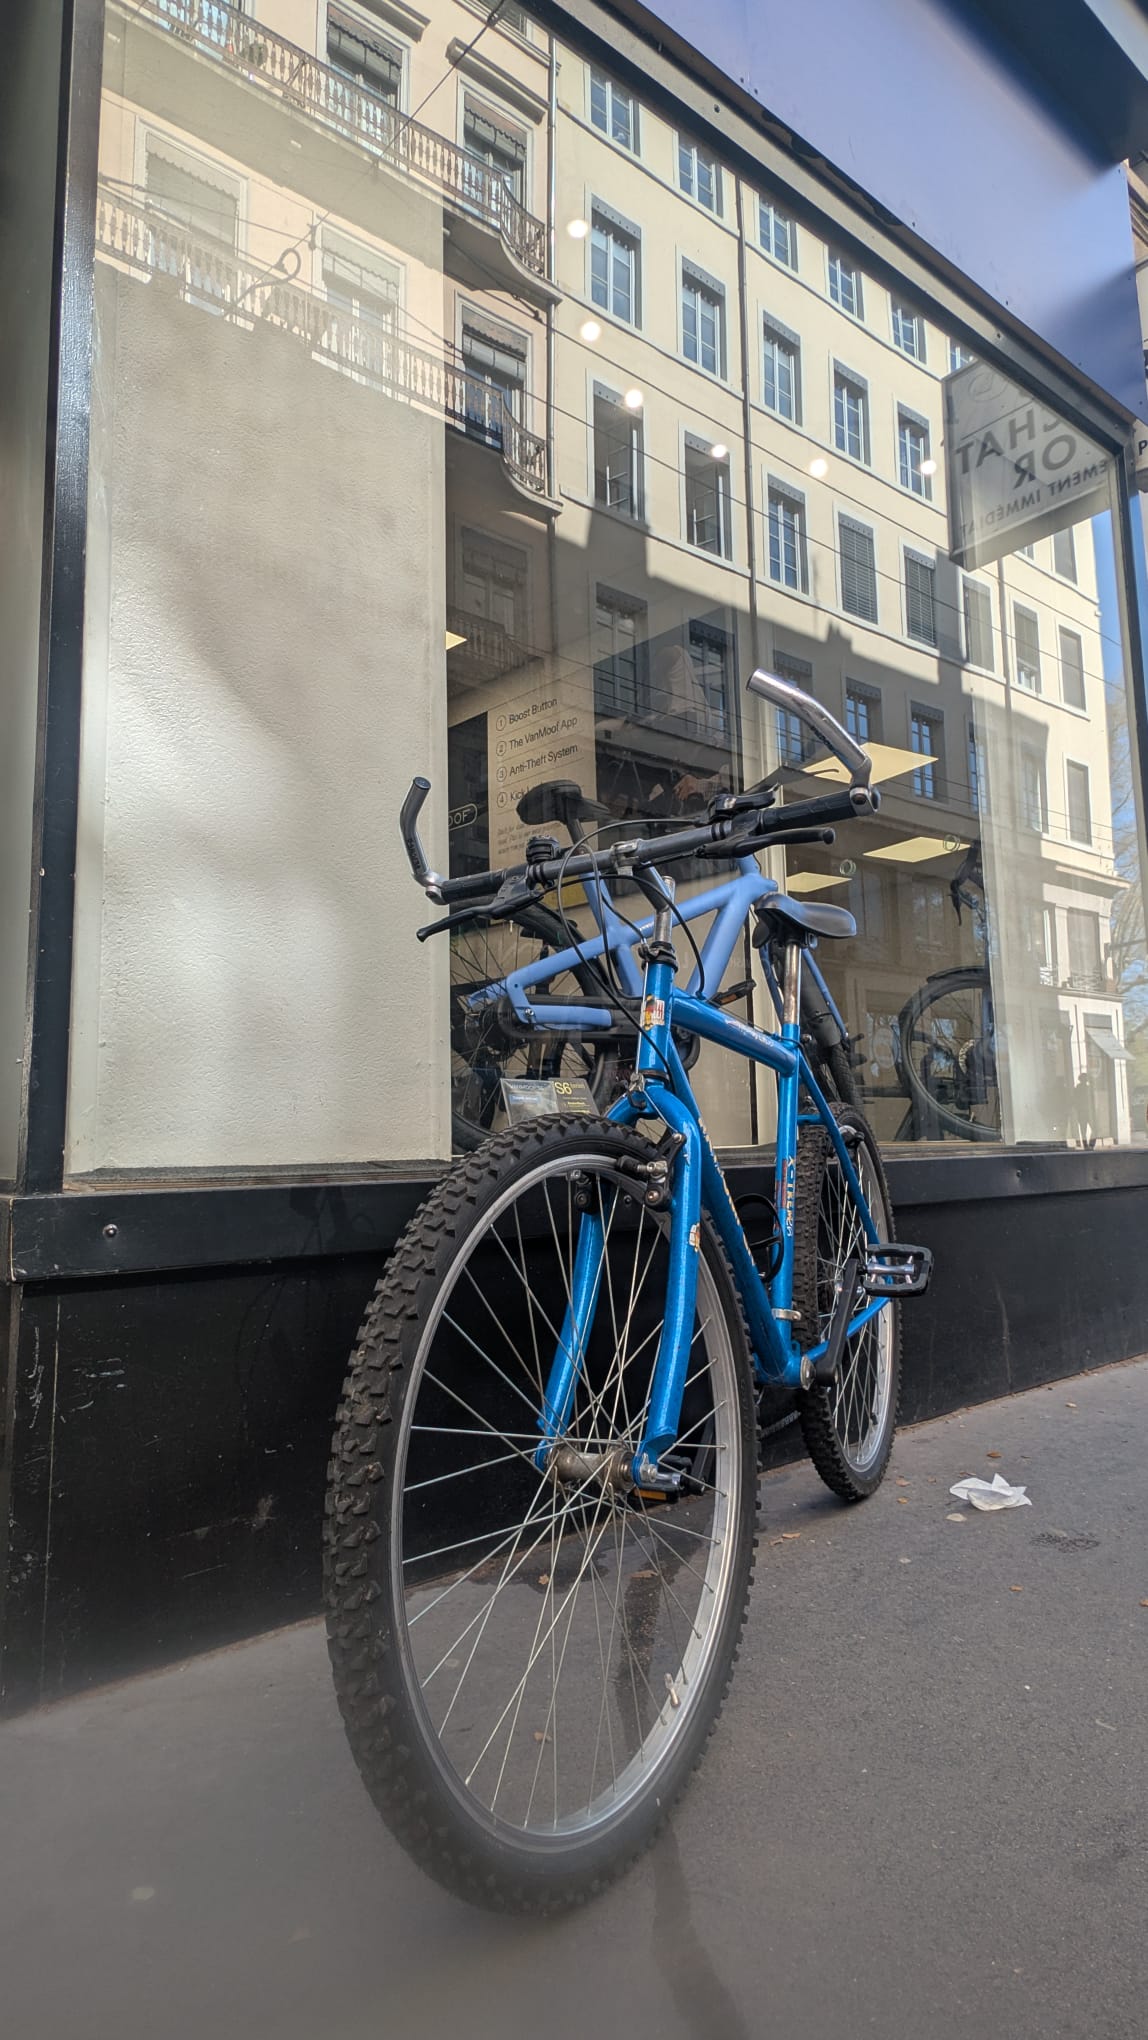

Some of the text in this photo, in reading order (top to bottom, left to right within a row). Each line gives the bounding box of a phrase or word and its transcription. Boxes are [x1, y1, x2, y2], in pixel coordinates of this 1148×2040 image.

[509, 708, 530, 724] Boost
[531, 699, 558, 714] Button
[509, 739, 523, 750] The
[524, 721, 559, 744] VanMoof
[561, 717, 578, 731] App
[510, 757, 547, 776] Anti-Theft
[547, 744, 578, 762] System
[554, 1081, 572, 1095] S6
